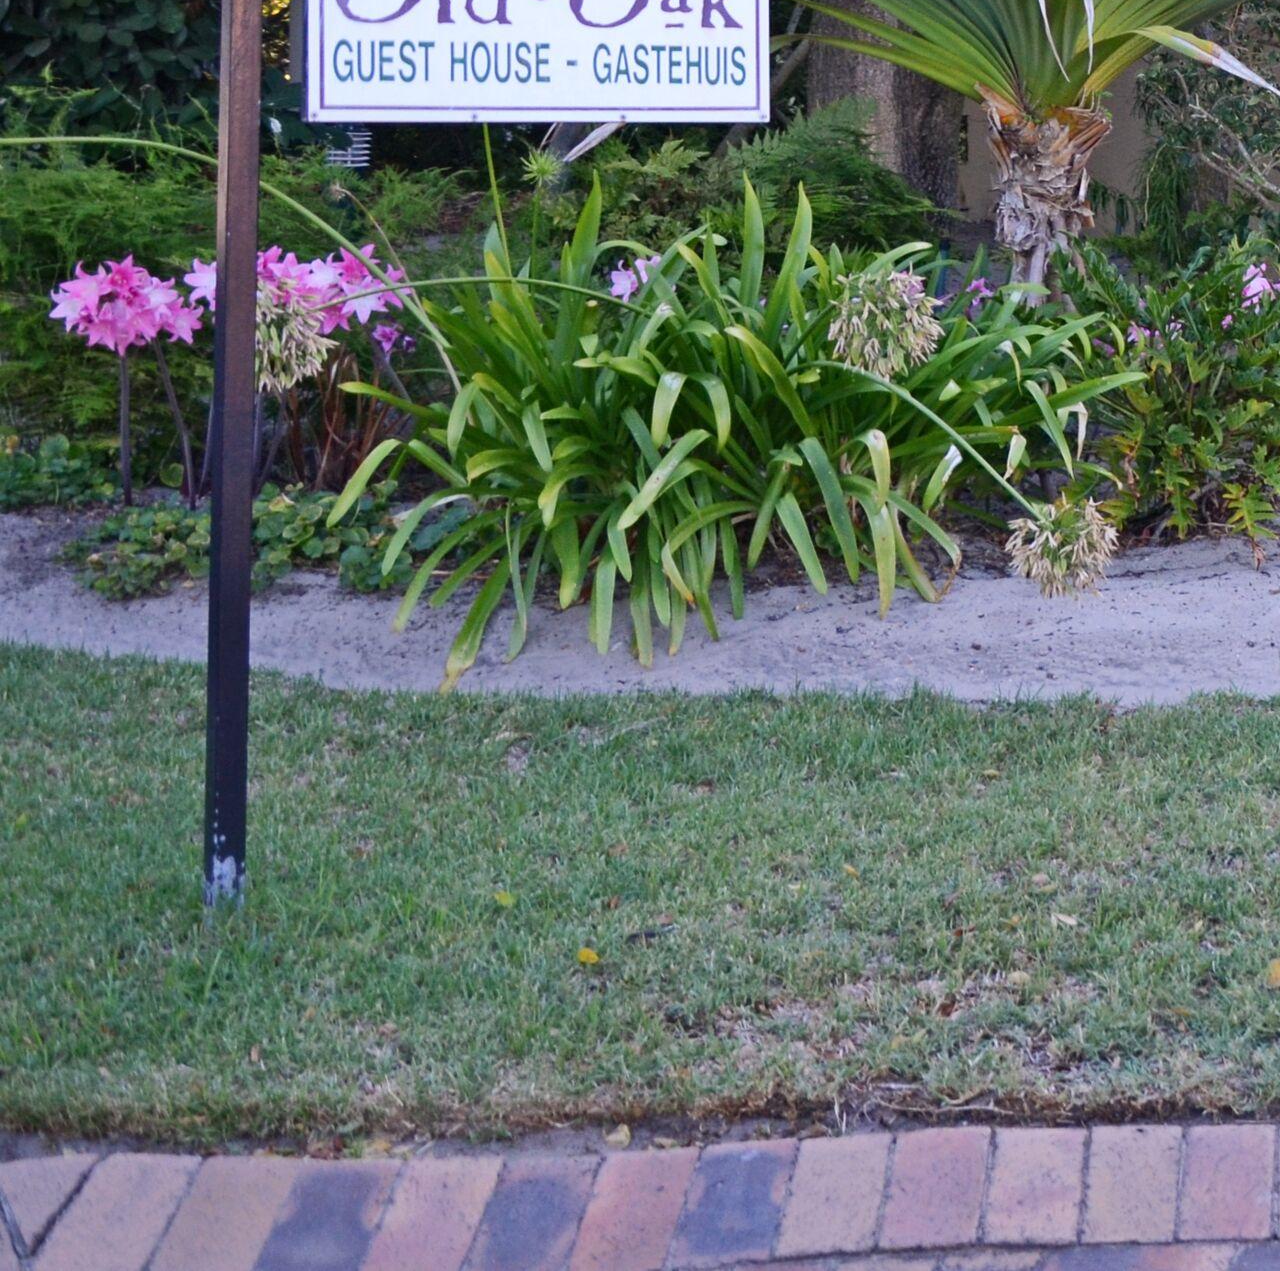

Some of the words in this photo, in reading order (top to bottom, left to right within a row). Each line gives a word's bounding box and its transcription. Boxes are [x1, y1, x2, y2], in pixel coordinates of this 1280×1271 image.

[333, 39, 435, 83] GUEST
[450, 41, 551, 83] HOUSE
[593, 44, 747, 87] GASTEHUIS
